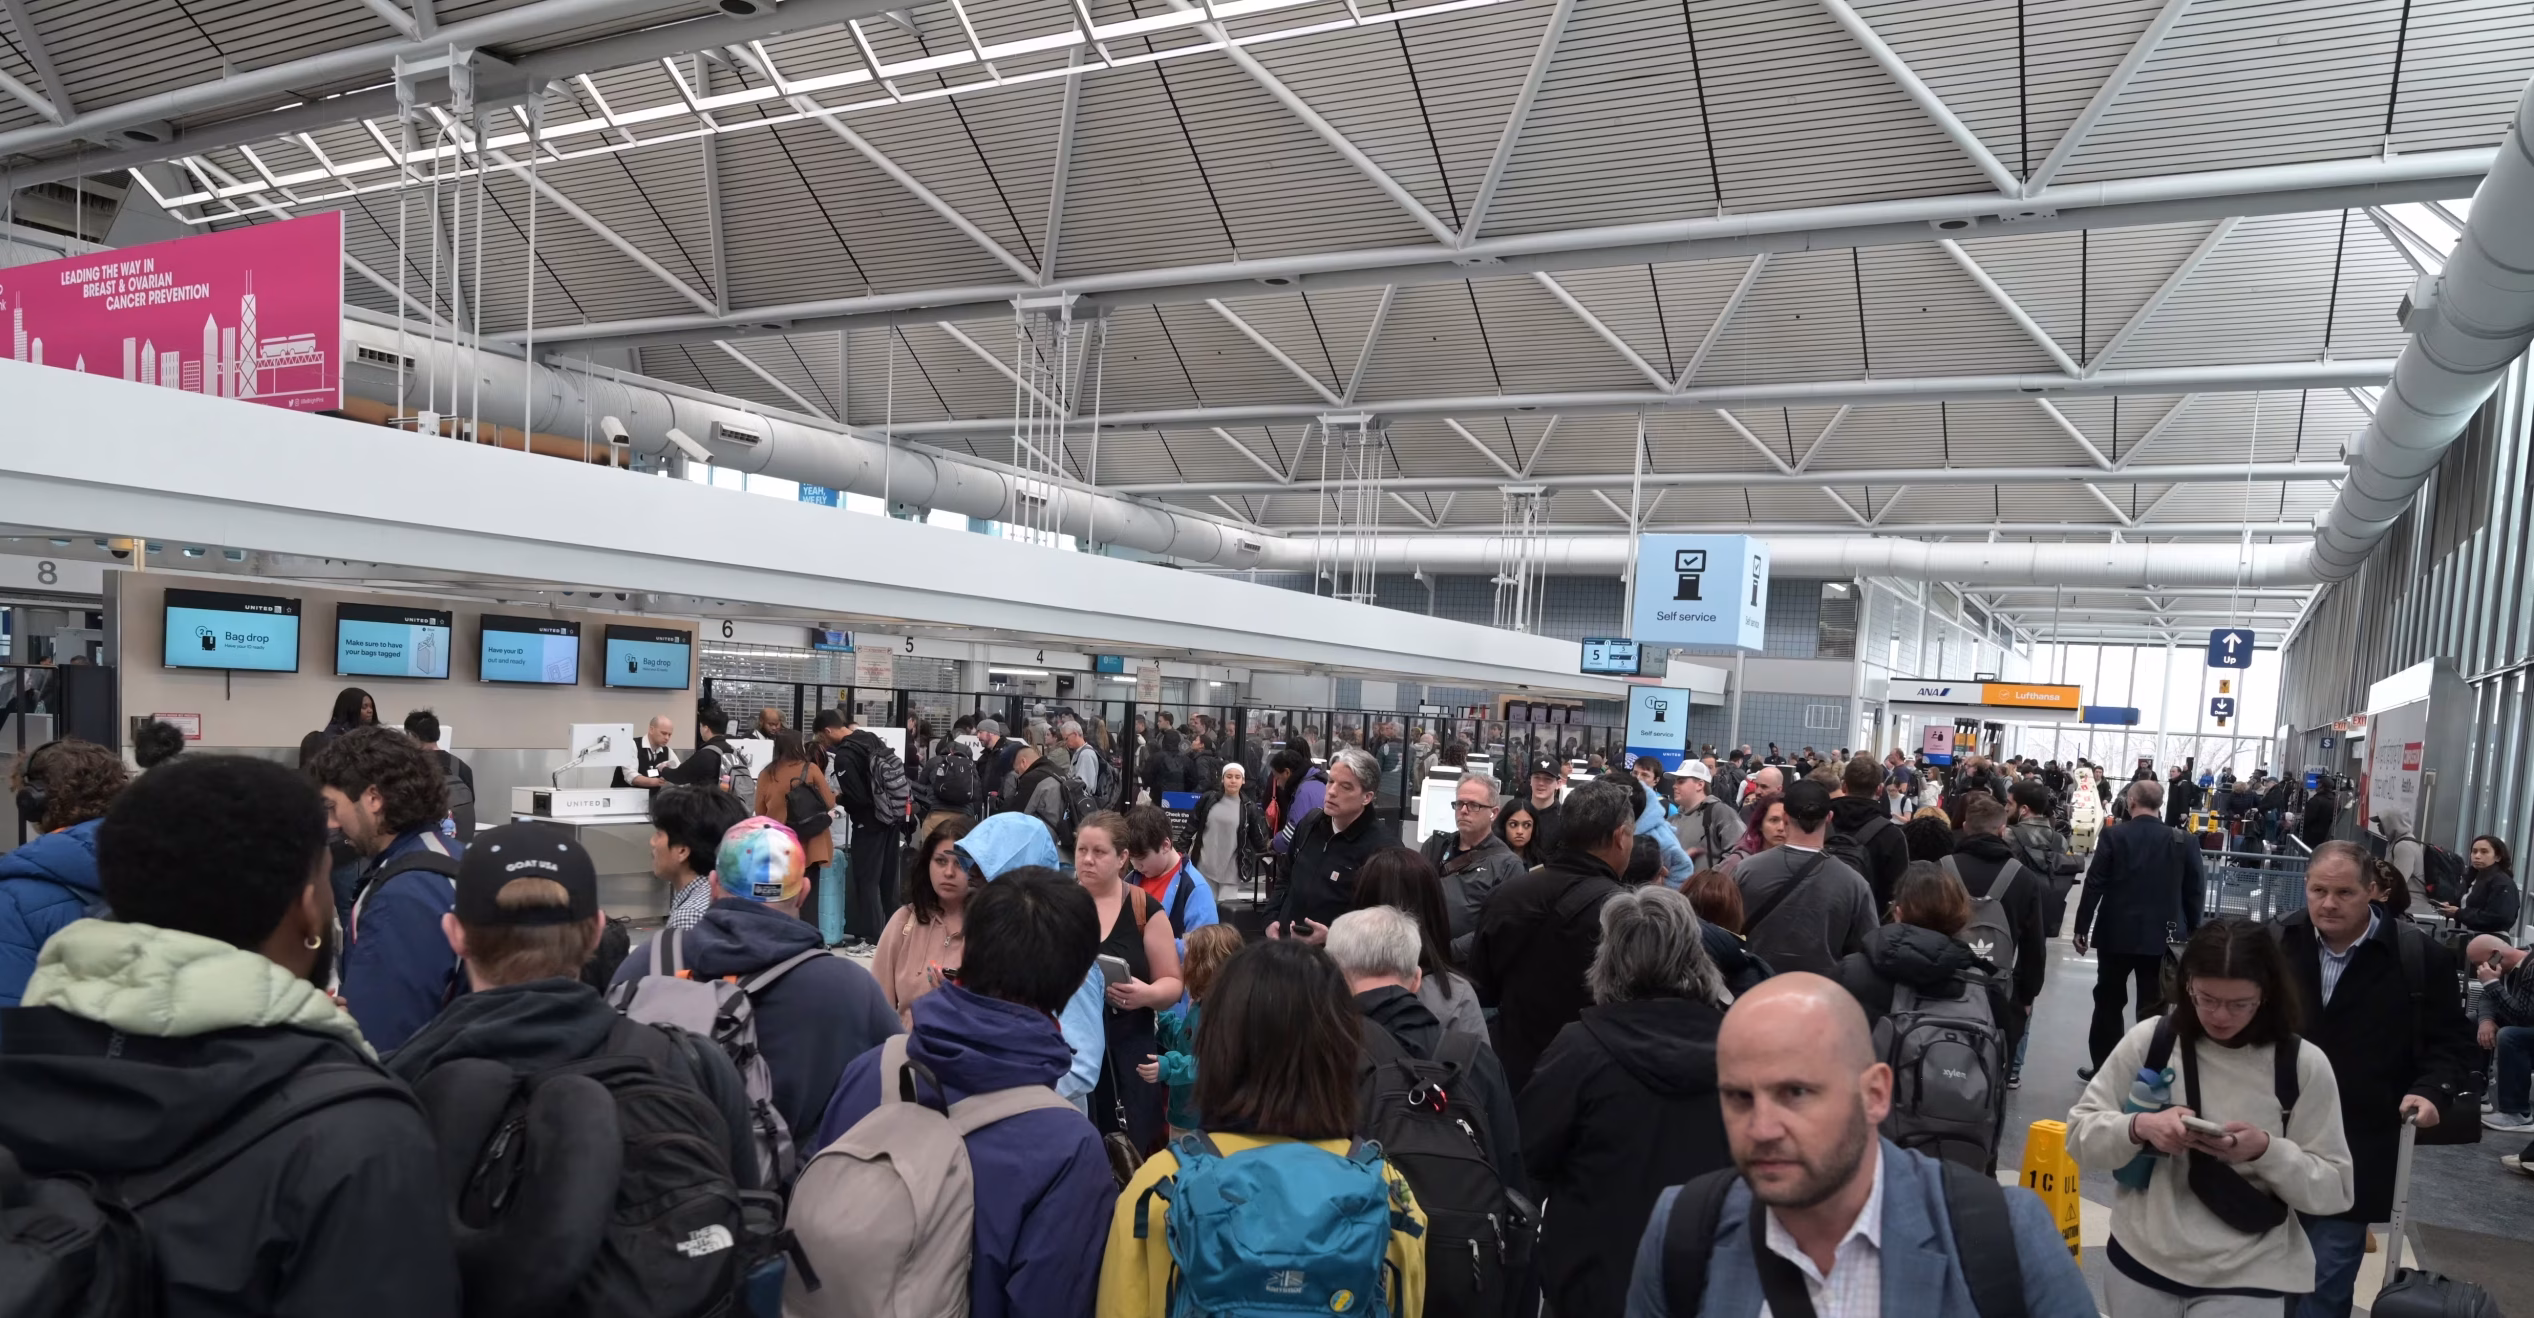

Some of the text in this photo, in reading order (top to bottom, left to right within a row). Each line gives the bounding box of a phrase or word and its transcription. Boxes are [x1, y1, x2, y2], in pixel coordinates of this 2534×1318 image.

[61, 258, 154, 286] LEADING THE WAY IN
[83, 272, 172, 298] BREAST & OVARIAN
[106, 283, 209, 311] CANCER PREVENTION
[803, 487, 826, 497] YEAH,
[815, 496, 827, 504] FLY
[38, 560, 58, 585] 8
[244, 604, 273, 612] UNITED
[1657, 611, 1717, 622] Self service
[722, 619, 733, 638] 6
[225, 631, 270, 644] Bag drop
[346, 639, 364, 647] Make
[387, 641, 403, 649] have
[905, 636, 914, 653] 5
[361, 649, 377, 658] bags
[378, 651, 401, 659] tagged
[1036, 649, 1044, 664] 4
[1593, 649, 1600, 661] 5
[509, 658, 526, 666] ready
[643, 657, 671, 668] Bag drop
[2223, 656, 2237, 665] Up
[840, 689, 845, 700] 6
[1917, 688, 1939, 696] ANA
[2015, 691, 2061, 701] Lufthansa
[2333, 721, 2347, 730] EXIT
[2353, 715, 2367, 725] EXIT
[566, 800, 601, 808] UNITED
[505, 859, 558, 871] GOAT USA
